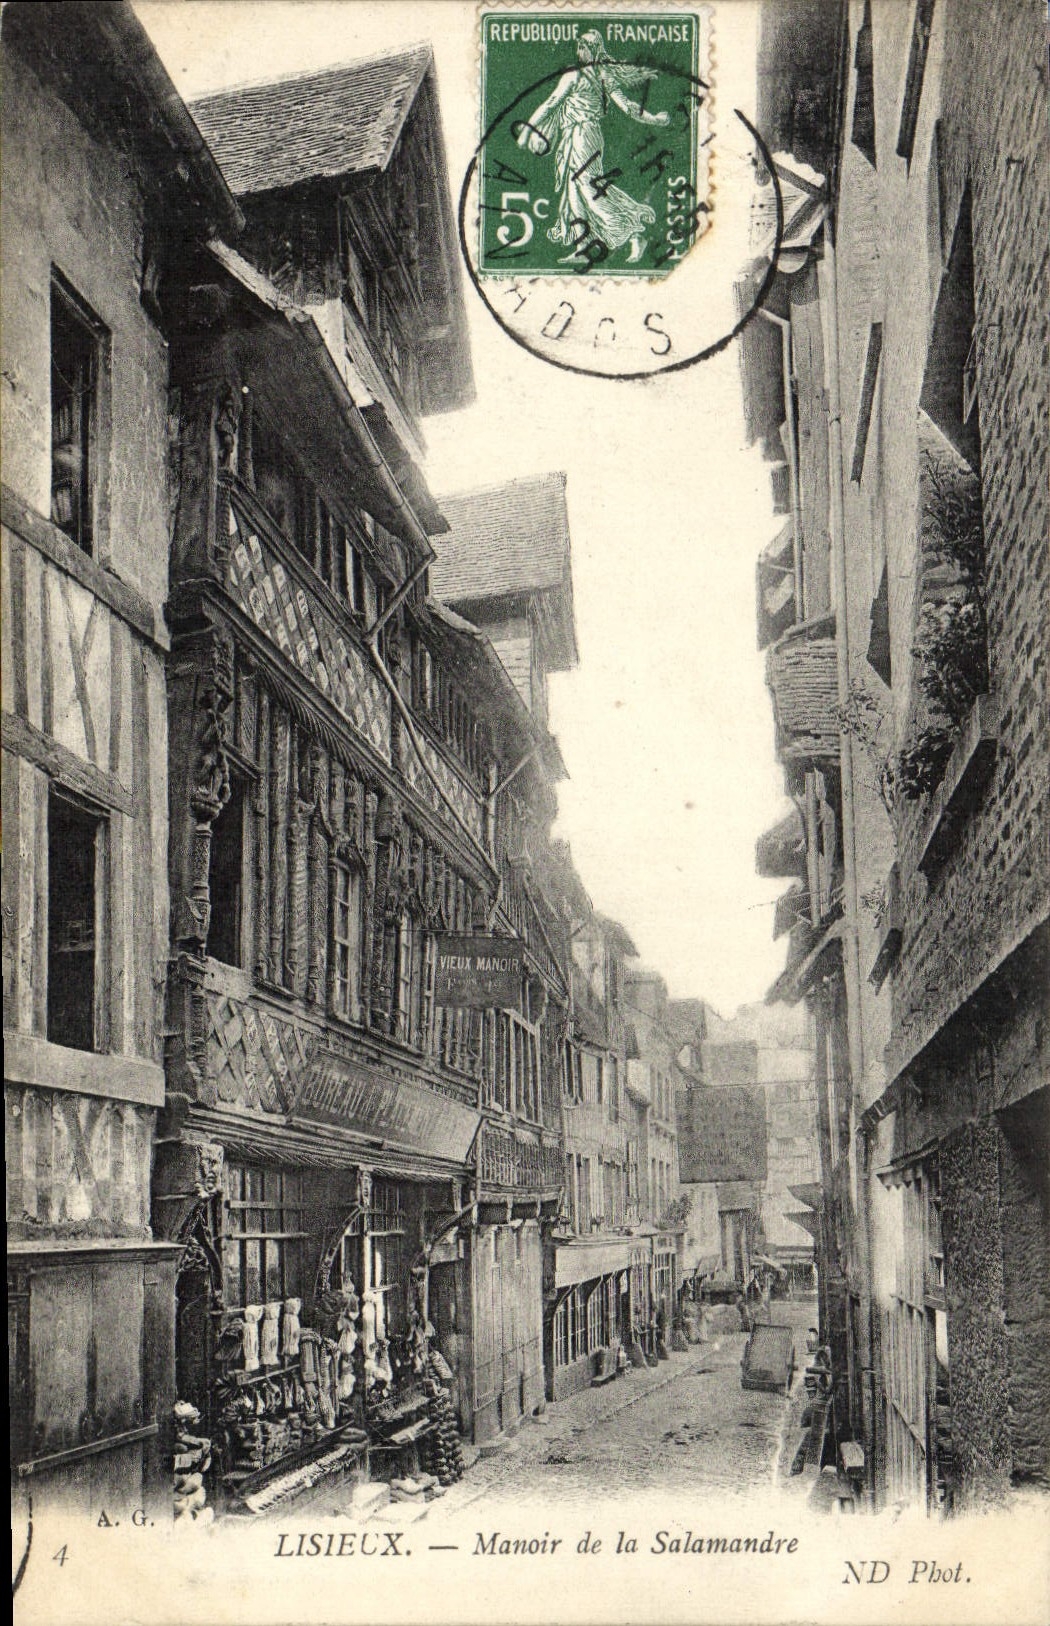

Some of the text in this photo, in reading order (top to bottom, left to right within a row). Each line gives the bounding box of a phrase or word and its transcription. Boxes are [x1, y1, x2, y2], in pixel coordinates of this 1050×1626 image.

[606, 23, 689, 45] FRANÇAISE
[440, 955, 519, 972] VIEUX MANOIR
[300, 1063, 367, 1119] BUREAU
